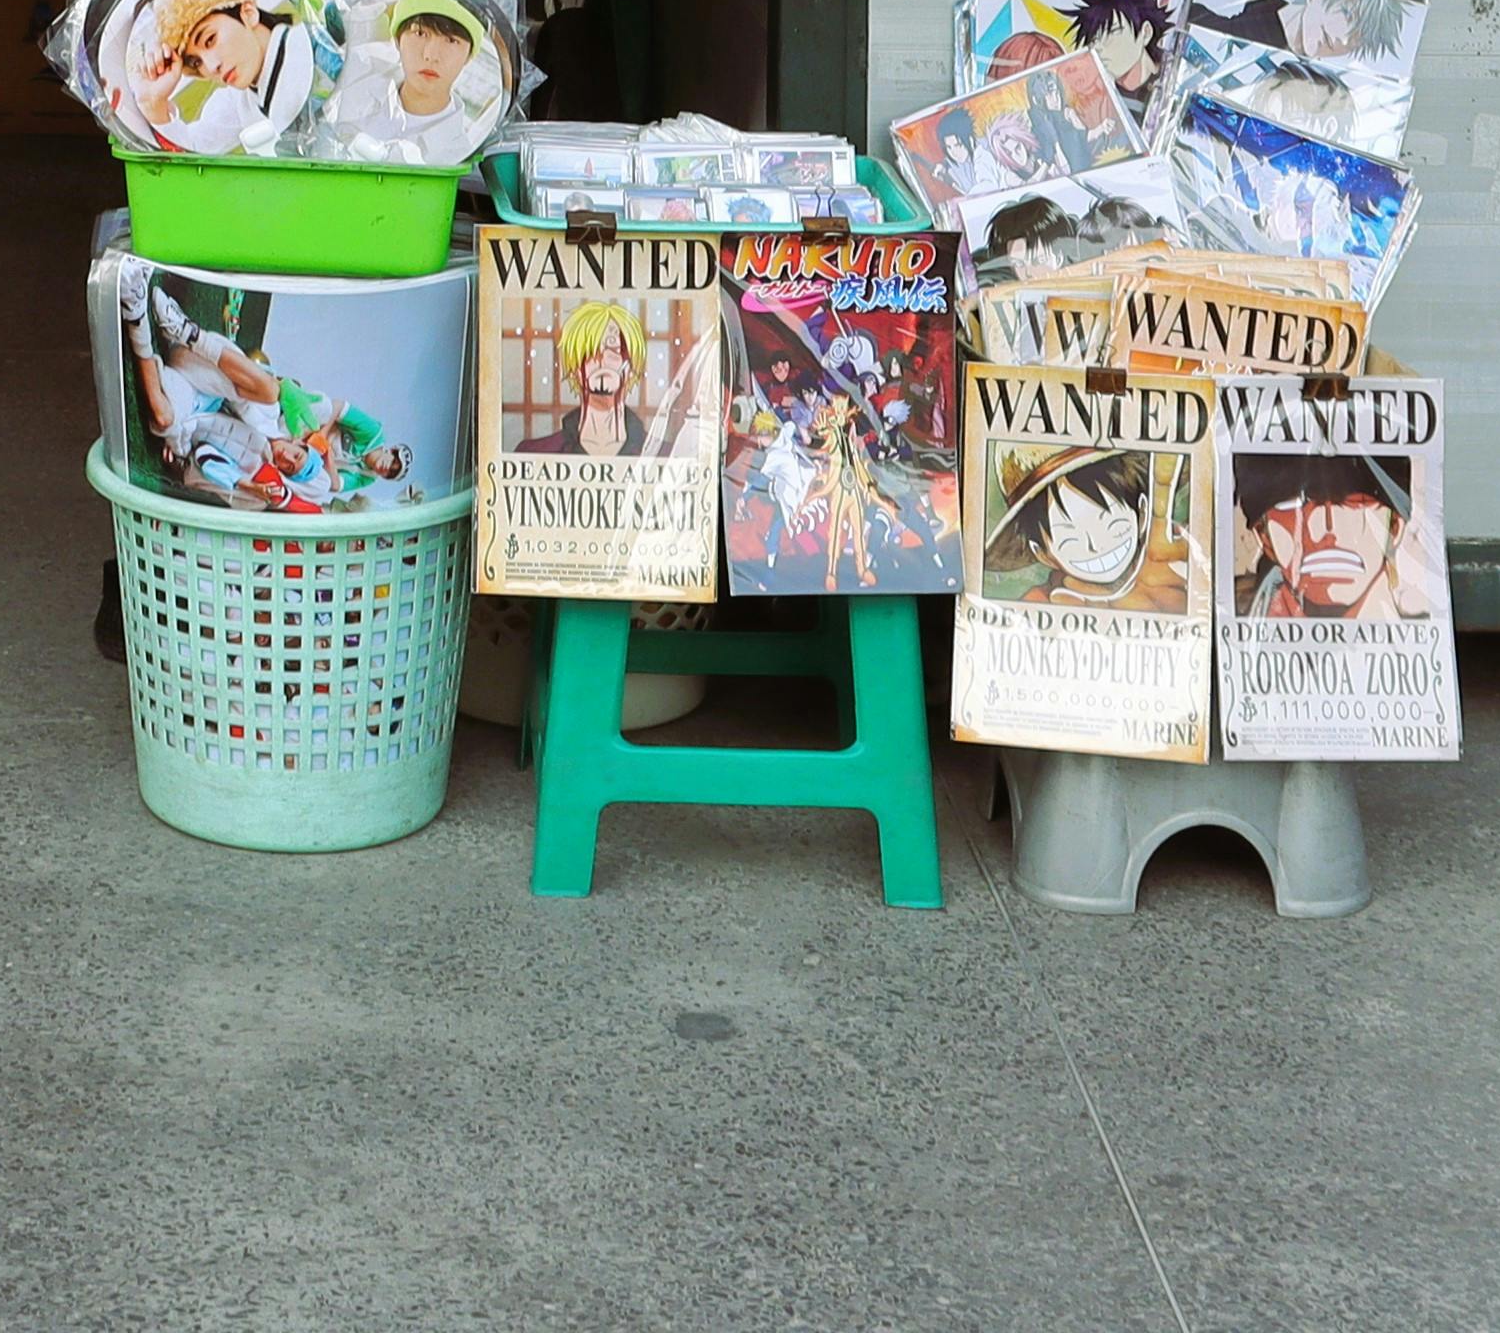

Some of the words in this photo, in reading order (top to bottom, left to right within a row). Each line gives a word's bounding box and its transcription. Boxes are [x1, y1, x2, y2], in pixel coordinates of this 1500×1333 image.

[491, 237, 717, 291] WANTED
[734, 235, 936, 281] NARUTO
[977, 376, 1210, 446] WANTED
[1217, 383, 1438, 446] WANTED
[502, 460, 576, 482] DEAD
[582, 461, 615, 482] OR
[623, 463, 702, 485] ALIVE
[504, 486, 625, 529] VINSMOKE
[631, 488, 696, 531] SANJI
[638, 565, 711, 586] MARINE
[982, 608, 1054, 632] DEAD
[1061, 612, 1098, 636] OR
[1237, 622, 1304, 643] DEAD
[1311, 623, 1346, 643] OR
[1353, 623, 1429, 643] ALIVE
[1241, 648, 1352, 696] RORONOA
[1366, 650, 1429, 696] ZORO
[1121, 717, 1200, 747] MARINE
[1370, 724, 1449, 748] MARINE
